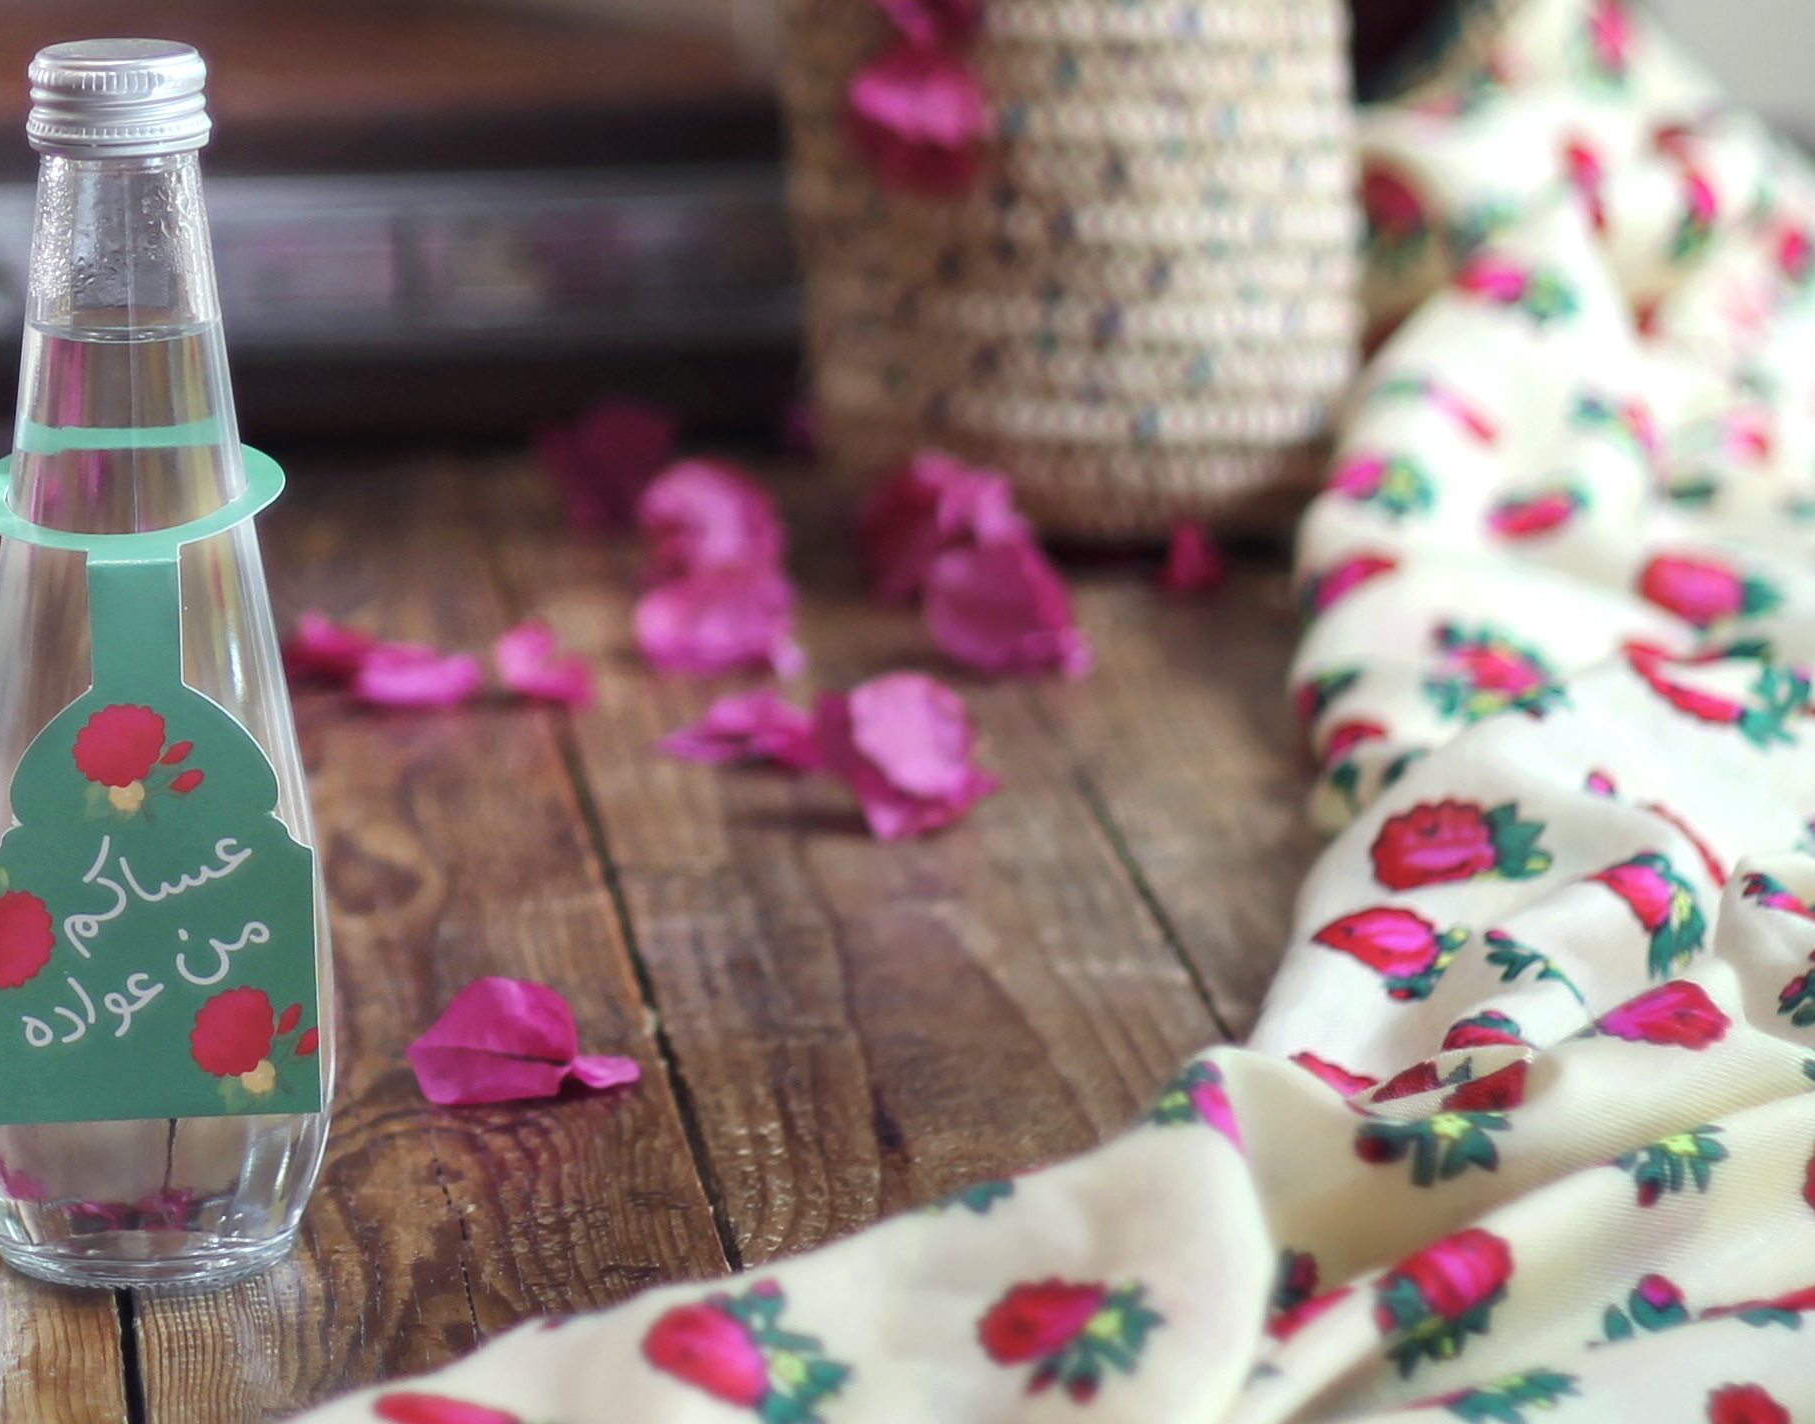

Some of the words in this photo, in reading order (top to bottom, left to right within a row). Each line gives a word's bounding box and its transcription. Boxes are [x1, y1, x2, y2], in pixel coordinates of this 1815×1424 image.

[63, 835, 252, 958] عساكم
[176, 921, 270, 985] من
[21, 973, 164, 1047] عواده
